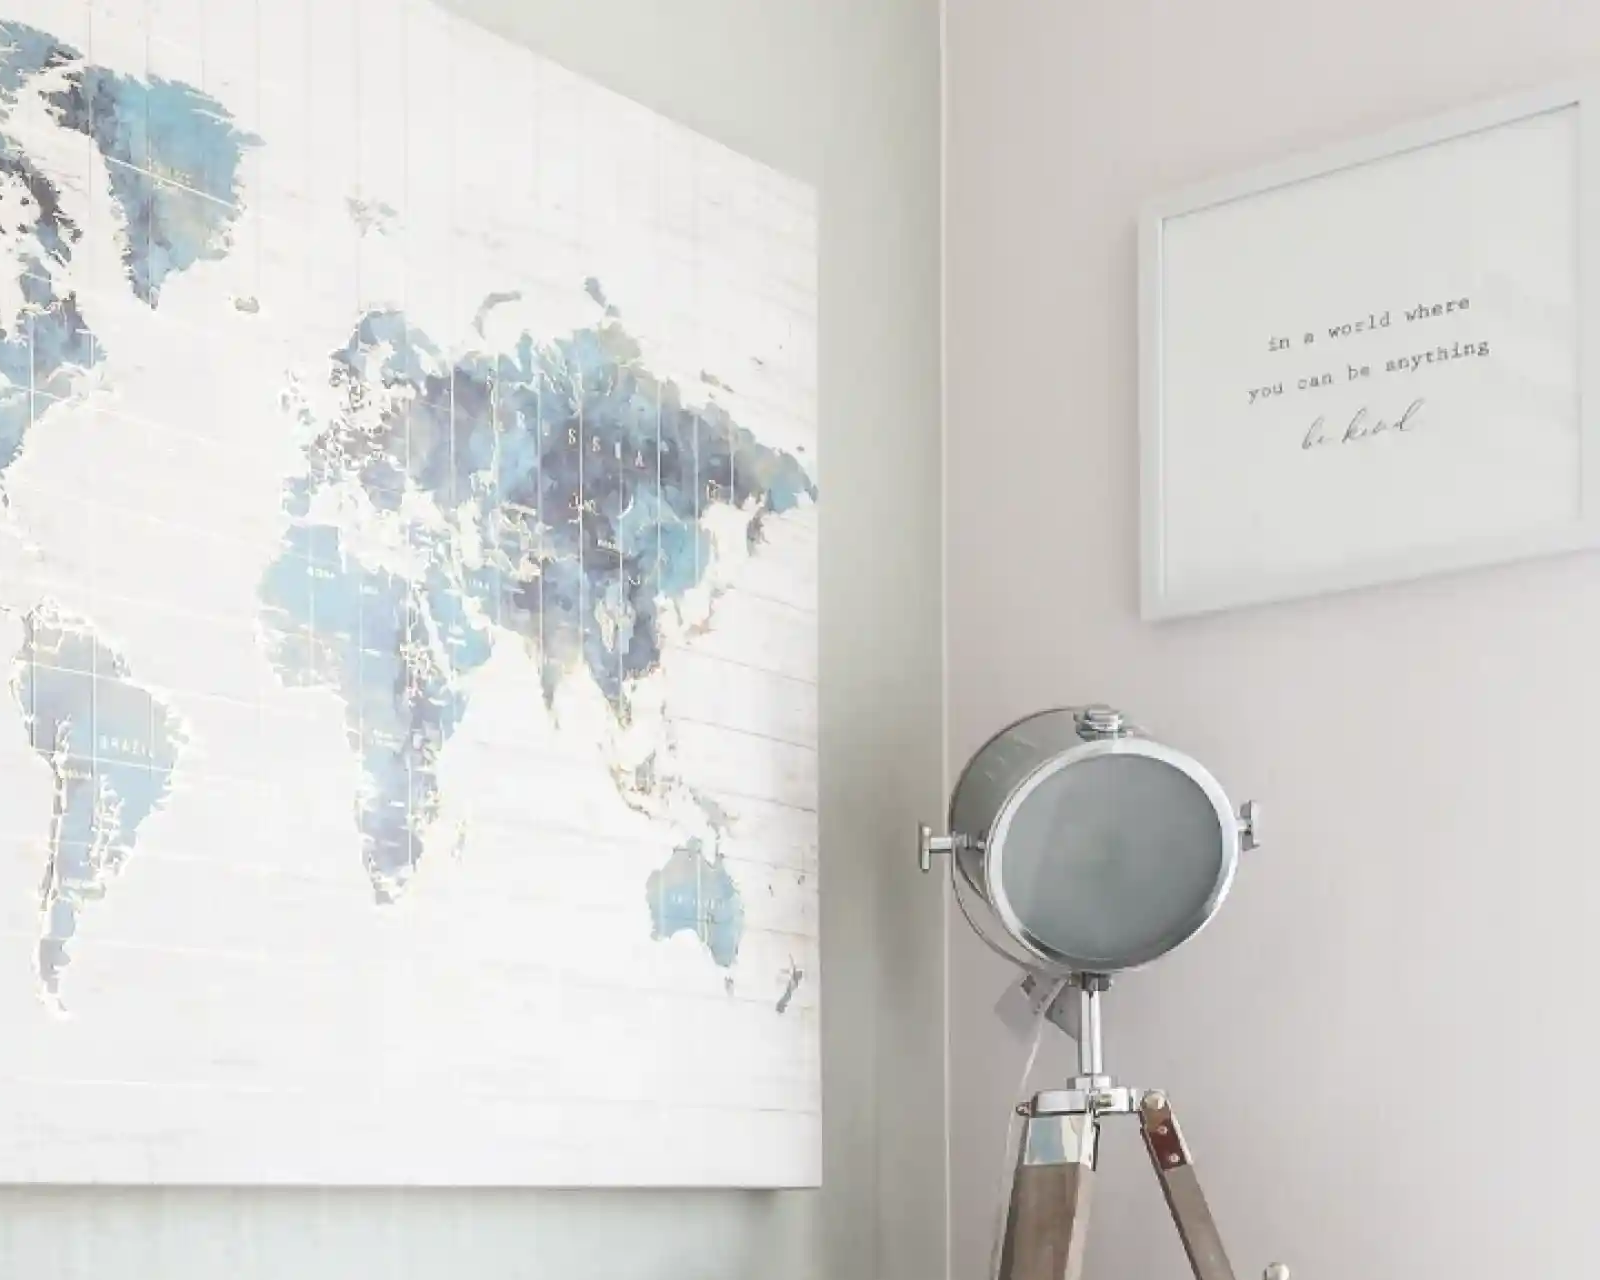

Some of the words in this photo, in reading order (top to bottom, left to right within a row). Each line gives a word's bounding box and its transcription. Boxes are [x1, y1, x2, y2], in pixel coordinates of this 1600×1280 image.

[1267, 335, 1290, 352] in
[1303, 332, 1315, 345] a
[1328, 311, 1391, 339] world
[1404, 297, 1470, 322] where
[1246, 381, 1284, 405] you
[1297, 371, 1333, 390] can
[1347, 364, 1371, 381] be
[1385, 340, 1491, 373] anything
